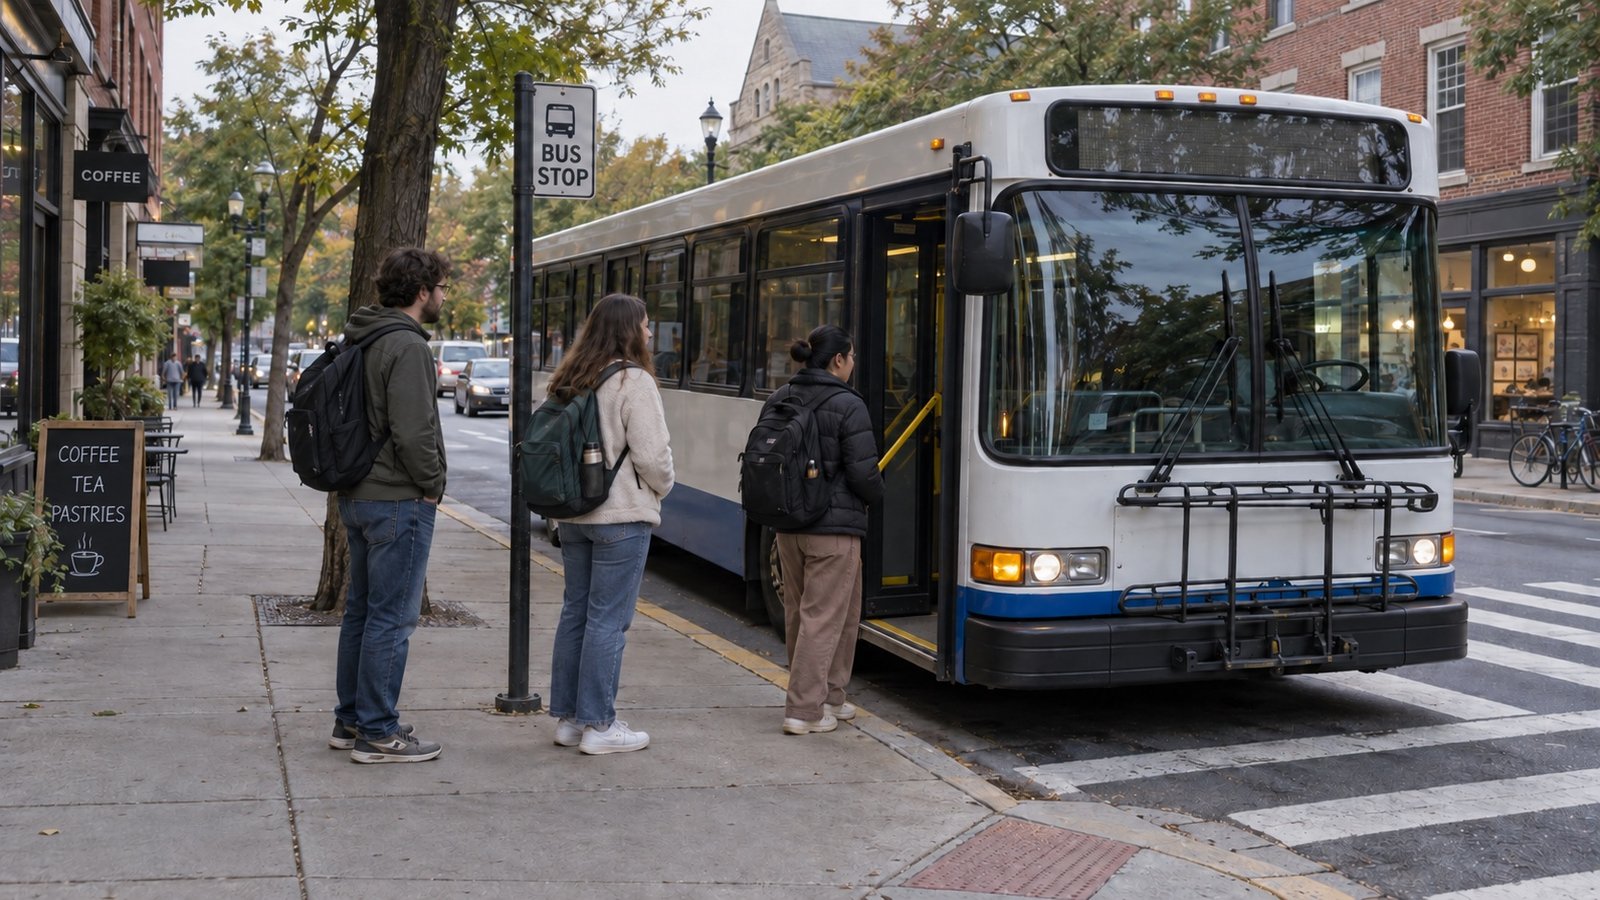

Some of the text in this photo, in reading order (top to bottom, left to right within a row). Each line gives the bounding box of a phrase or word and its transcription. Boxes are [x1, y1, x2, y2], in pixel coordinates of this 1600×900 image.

[542, 143, 582, 163] BUS
[81, 169, 141, 184] COFFEE
[538, 167, 589, 187] STOP
[58, 445, 120, 463] COFFEE
[72, 475, 105, 493] TEA
[51, 505, 125, 523] PASTRIES
